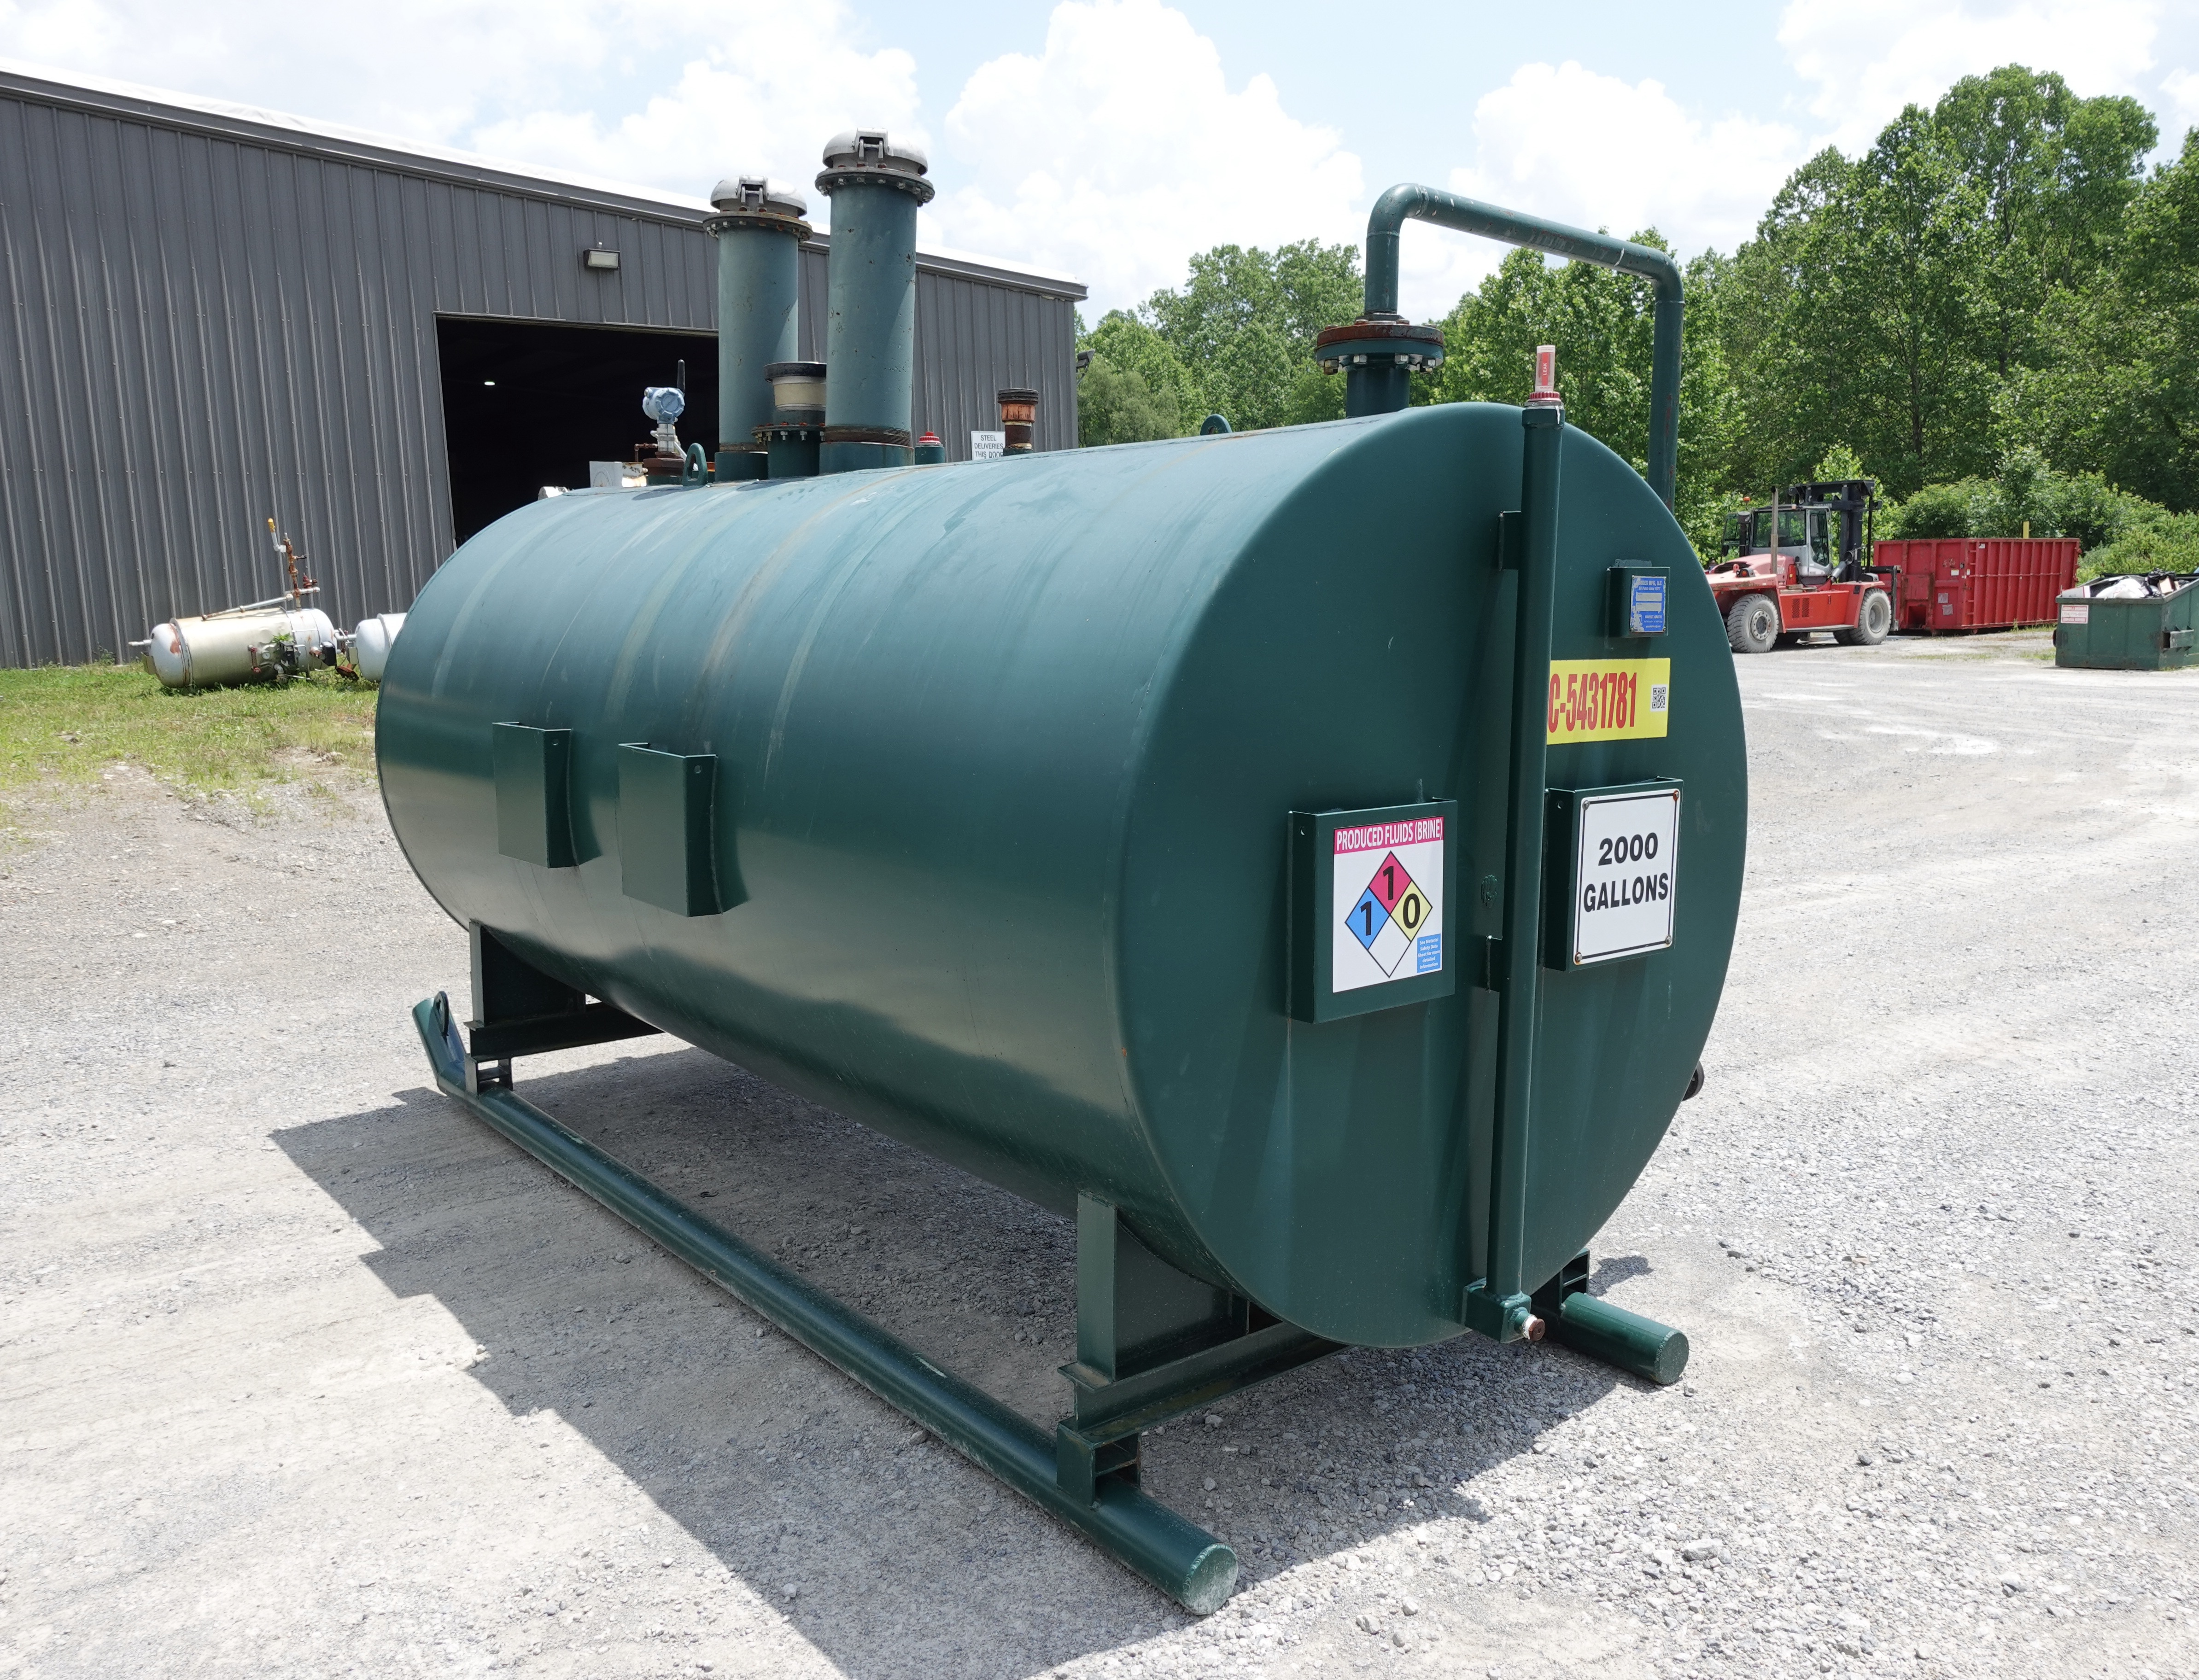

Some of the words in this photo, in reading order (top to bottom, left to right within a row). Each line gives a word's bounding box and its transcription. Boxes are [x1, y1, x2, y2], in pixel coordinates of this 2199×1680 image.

[1548, 672, 1637, 733] C-5431781
[1337, 827, 1383, 851] PRODUCED
[1385, 822, 1413, 845] FLUIDS
[1415, 818, 1442, 843] (BRINE)
[1598, 833, 1658, 866] 2000
[1383, 866, 1393, 900] 1
[1584, 873, 1668, 912] GALLONS
[1360, 901, 1371, 936] 1
[1403, 893, 1420, 929] 0
